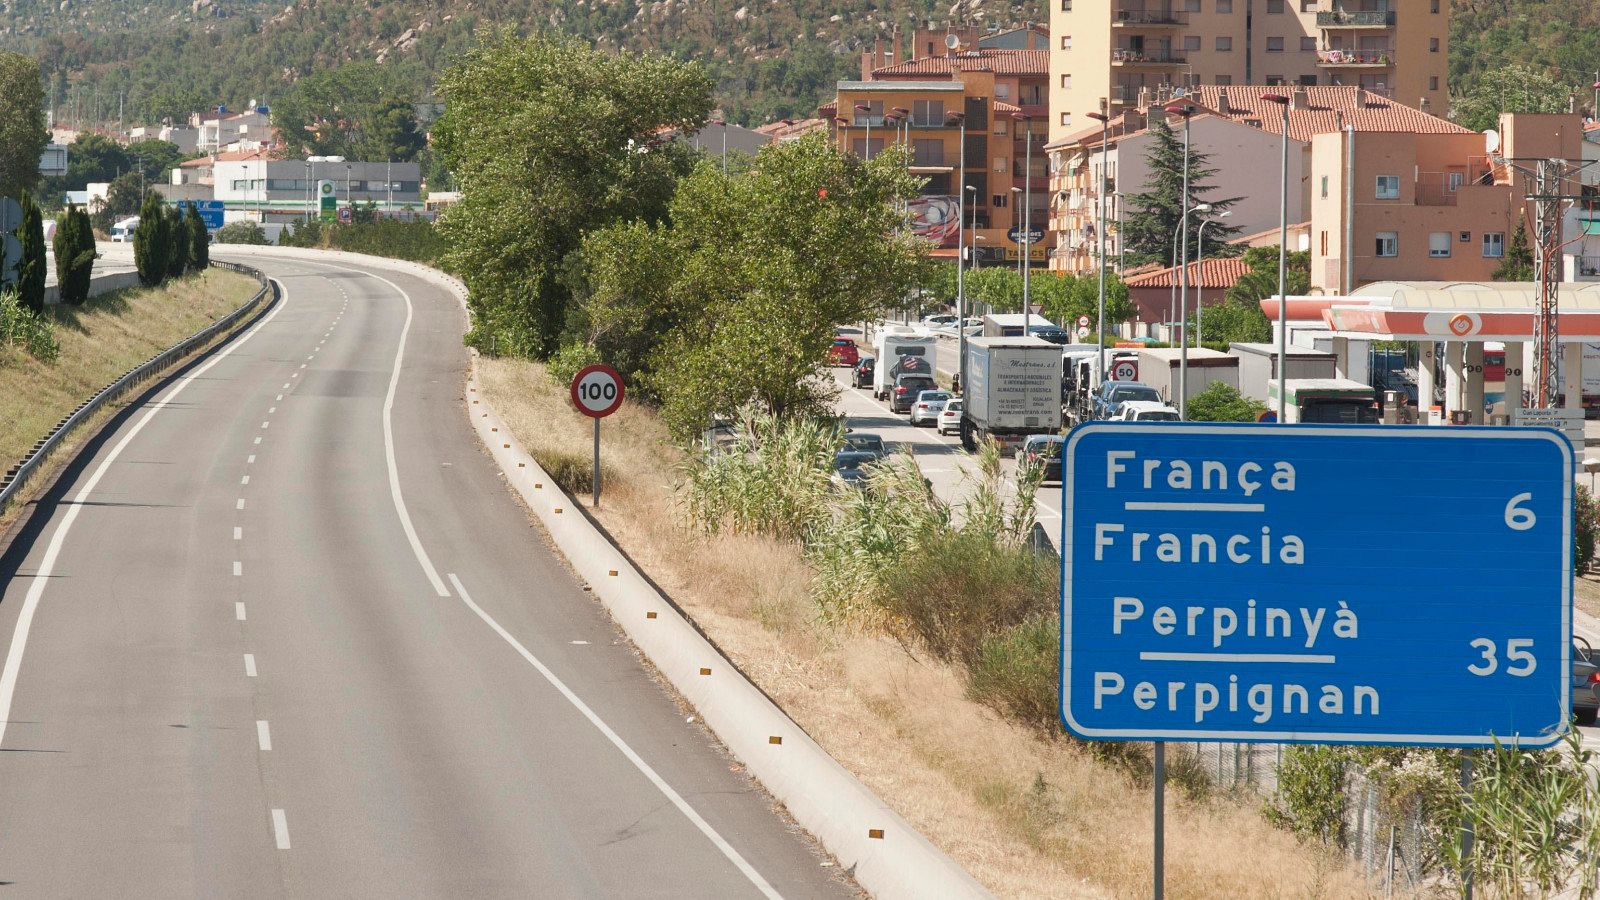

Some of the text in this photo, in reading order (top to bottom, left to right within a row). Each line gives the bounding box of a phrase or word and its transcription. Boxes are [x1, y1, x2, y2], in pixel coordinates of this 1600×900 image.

[580, 382, 616, 401] 100
[1118, 368, 1133, 377] 50
[1107, 451, 1296, 497] França
[1505, 493, 1537, 531] 6
[1094, 523, 1305, 565] Francia
[1113, 596, 1359, 649] Perpinyà
[1467, 637, 1537, 678] 35
[1094, 671, 1380, 725] Perpignan
